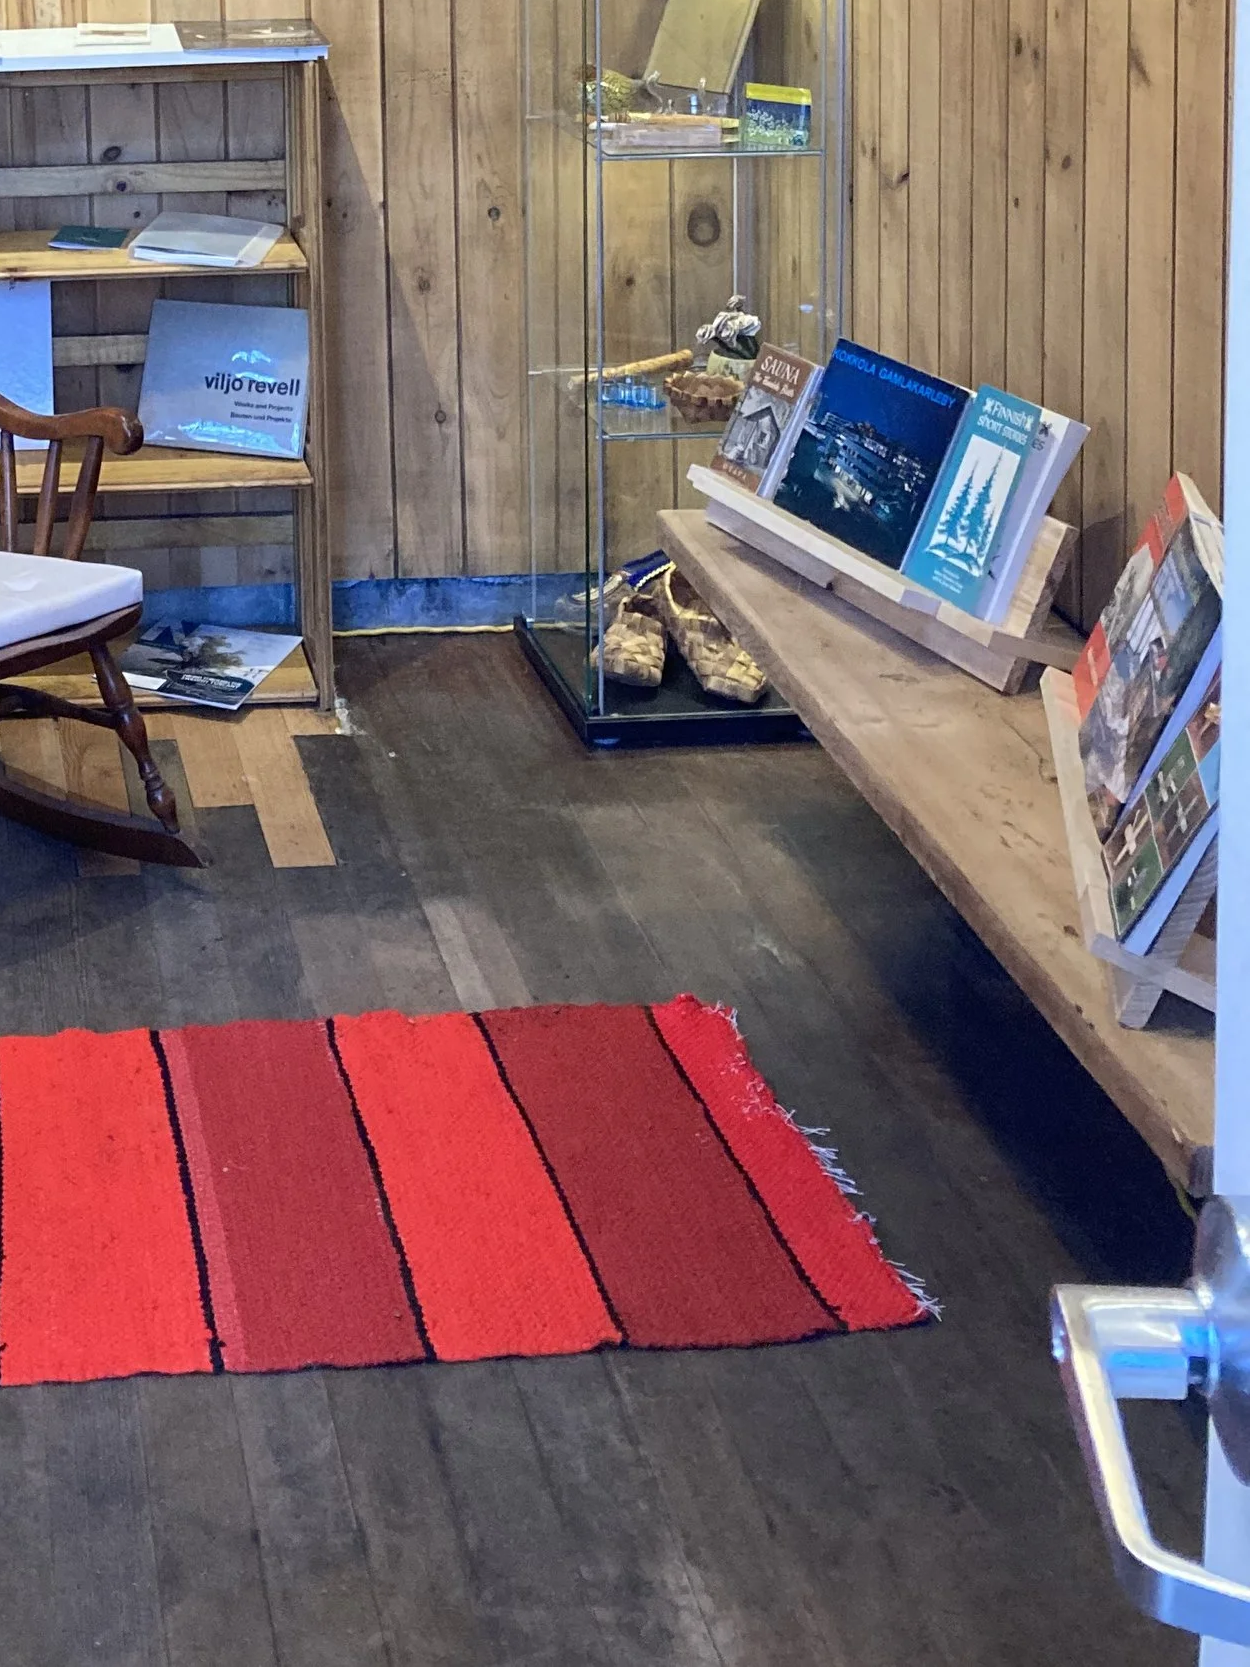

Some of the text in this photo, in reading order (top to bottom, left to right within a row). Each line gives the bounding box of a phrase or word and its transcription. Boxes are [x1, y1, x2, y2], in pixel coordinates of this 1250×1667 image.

[761, 355, 800, 385] SAUNA
[833, 348, 877, 376] KOKKOLA
[205, 372, 300, 397] viljo revell
